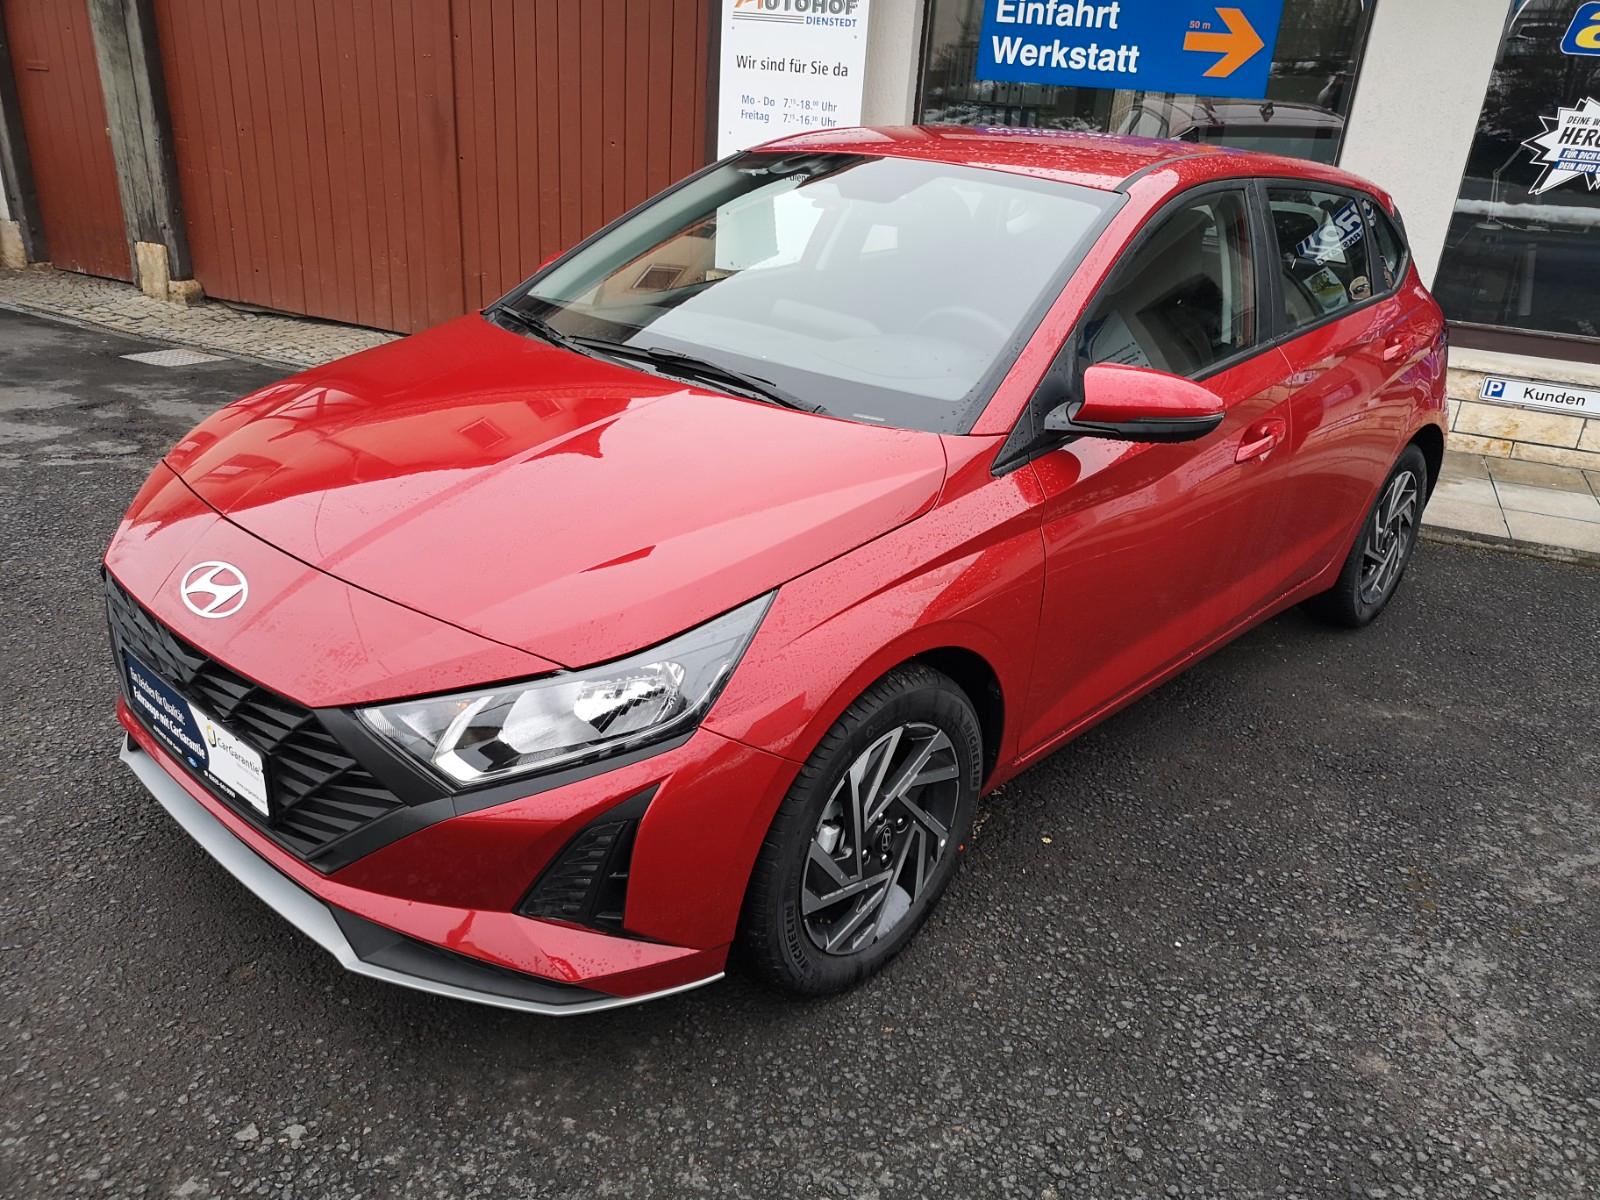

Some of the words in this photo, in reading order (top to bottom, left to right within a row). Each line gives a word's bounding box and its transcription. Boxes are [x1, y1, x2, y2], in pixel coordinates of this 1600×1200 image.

[806, 16, 857, 28] DIENSTEDT
[996, 0, 1120, 30] Einfahrt
[1189, 20, 1201, 29] 50
[1202, 22, 1211, 30] m
[992, 36, 1140, 73] Werkstatt
[736, 55, 757, 69] Wir
[760, 57, 785, 72] sind
[789, 58, 807, 74] für
[810, 61, 829, 76] Sie
[833, 62, 848, 77] da
[741, 95, 755, 105] Mo
[764, 96, 775, 107] Do
[821, 101, 838, 113] Uhr
[741, 109, 770, 123] Freitag
[821, 117, 837, 127] Uhr
[1567, 115, 1591, 125] DEINE
[1563, 148, 1578, 159] FÜR
[1558, 161, 1576, 170] DEIN
[1576, 163, 1596, 173] AUTO
[1523, 387, 1586, 406] Kunden
